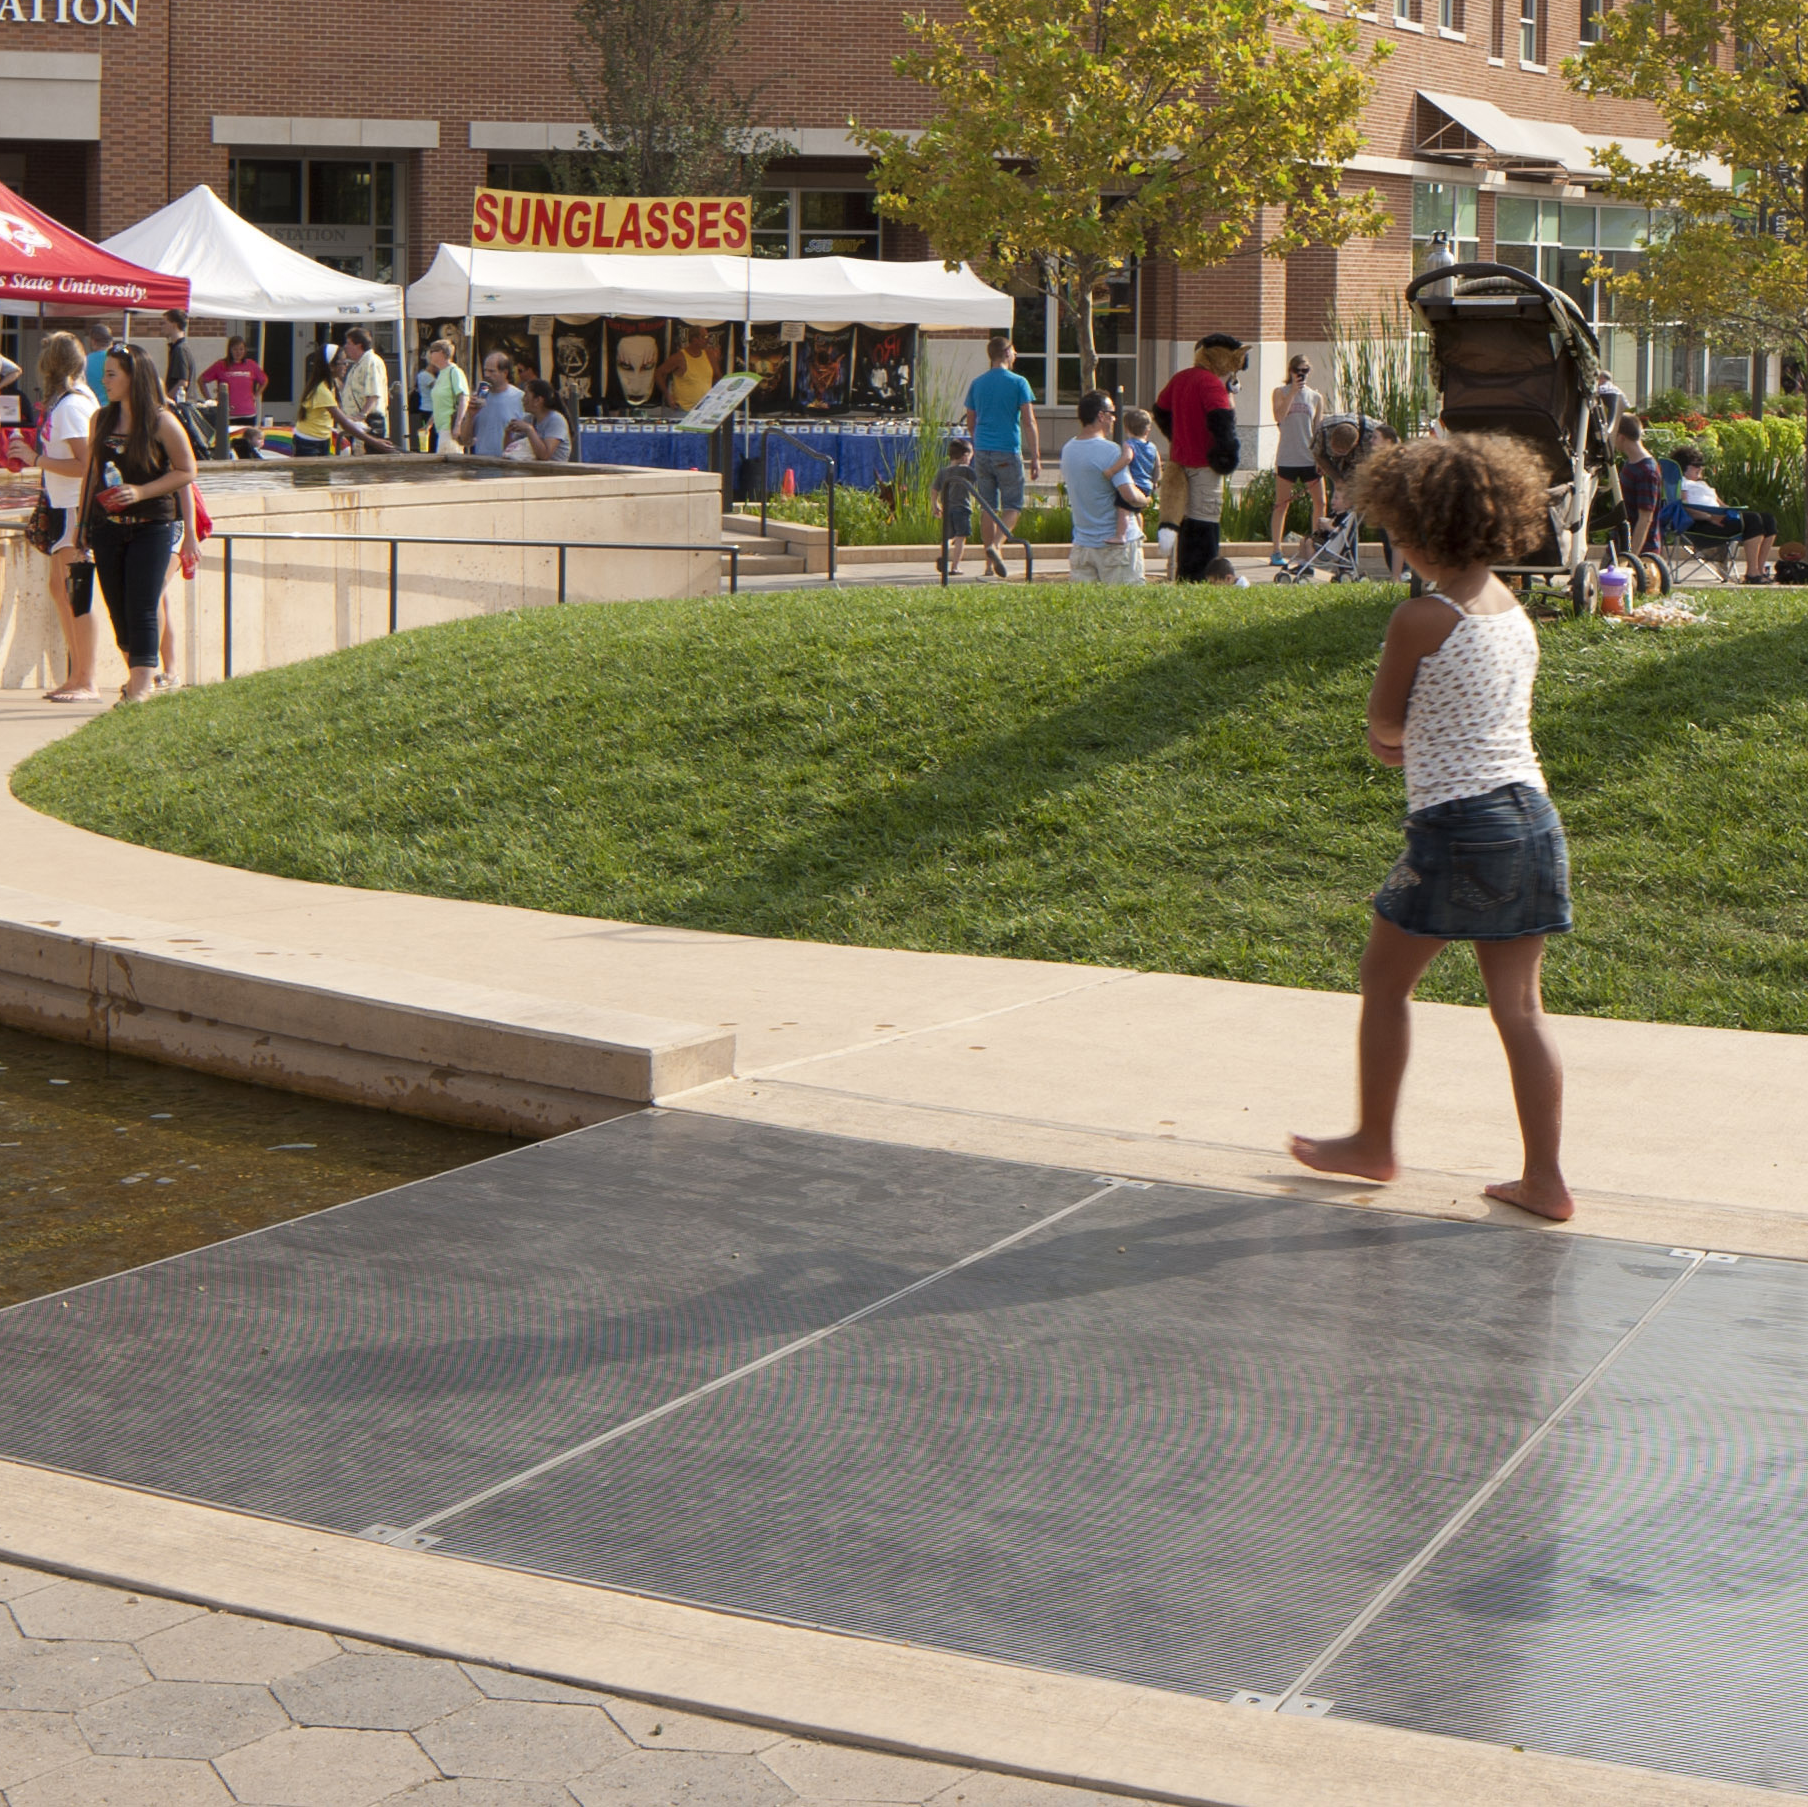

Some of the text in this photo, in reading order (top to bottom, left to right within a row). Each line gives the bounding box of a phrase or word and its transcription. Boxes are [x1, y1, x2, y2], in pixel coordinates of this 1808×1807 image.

[473, 193, 747, 249] SUNGLASSES
[9, 273, 54, 292] State
[58, 277, 147, 303] University
